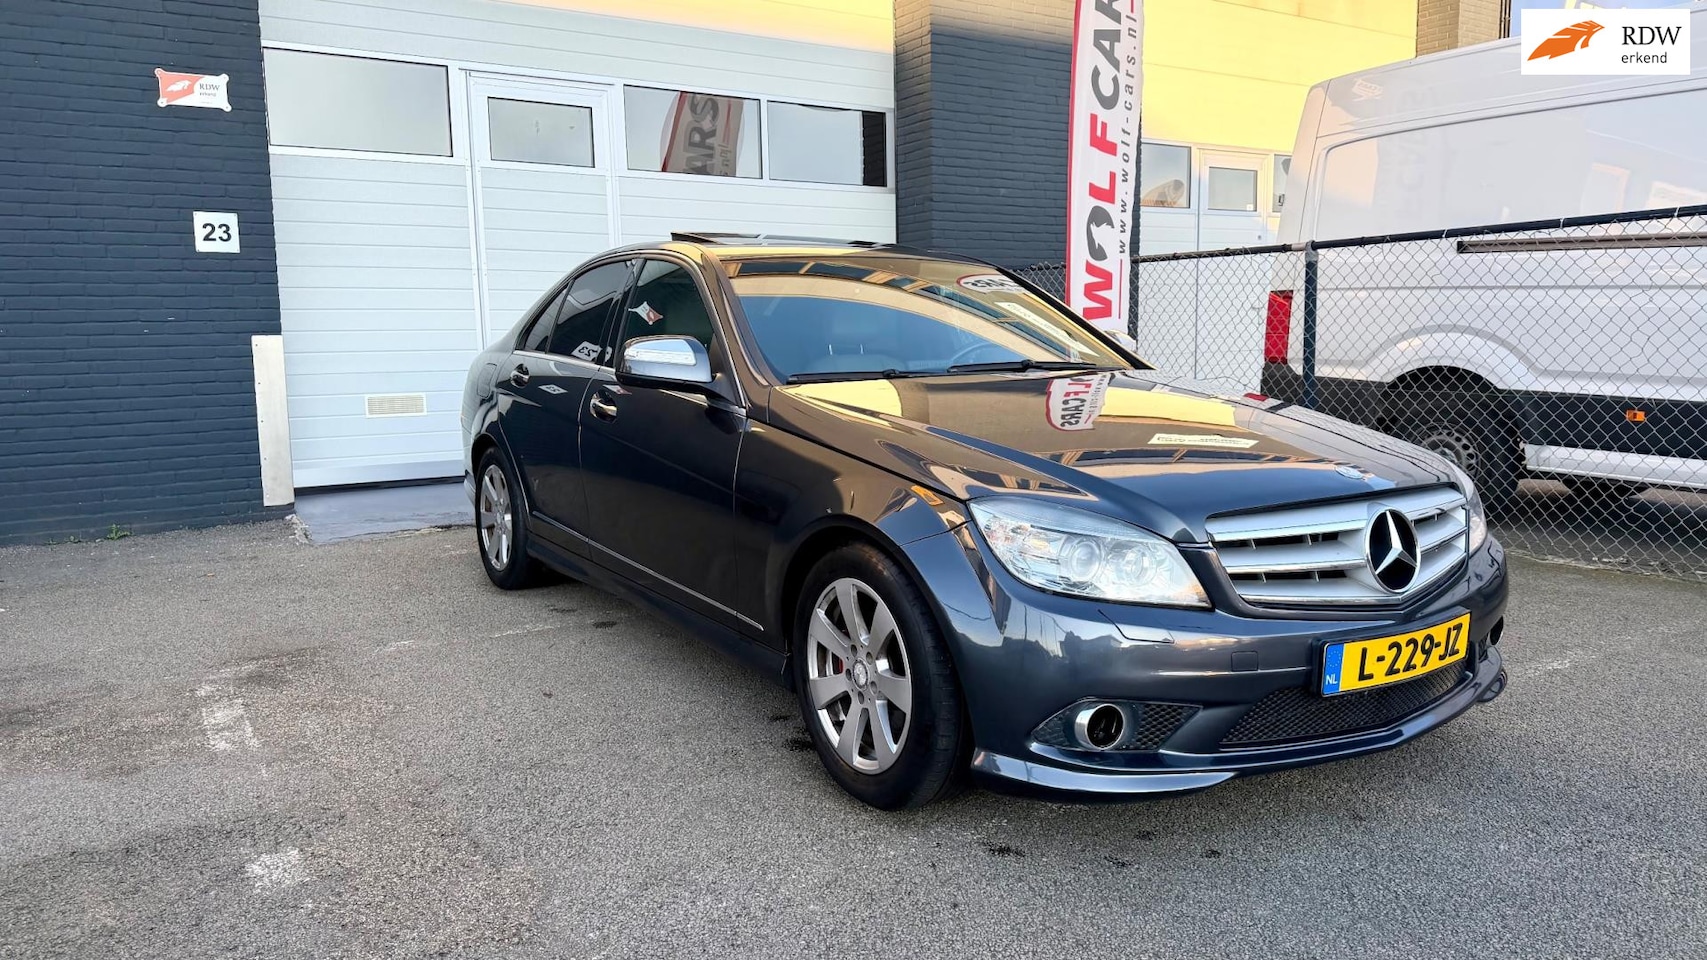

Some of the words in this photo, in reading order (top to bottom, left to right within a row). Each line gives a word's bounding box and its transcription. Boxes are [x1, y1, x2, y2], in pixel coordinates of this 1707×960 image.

[199, 83, 220, 91] RDW
[1119, 14, 1138, 254] www.wolf-cars.nl
[202, 222, 232, 242] 23
[1358, 622, 1463, 682] L-229-JZ
[1325, 674, 1338, 685] NL
